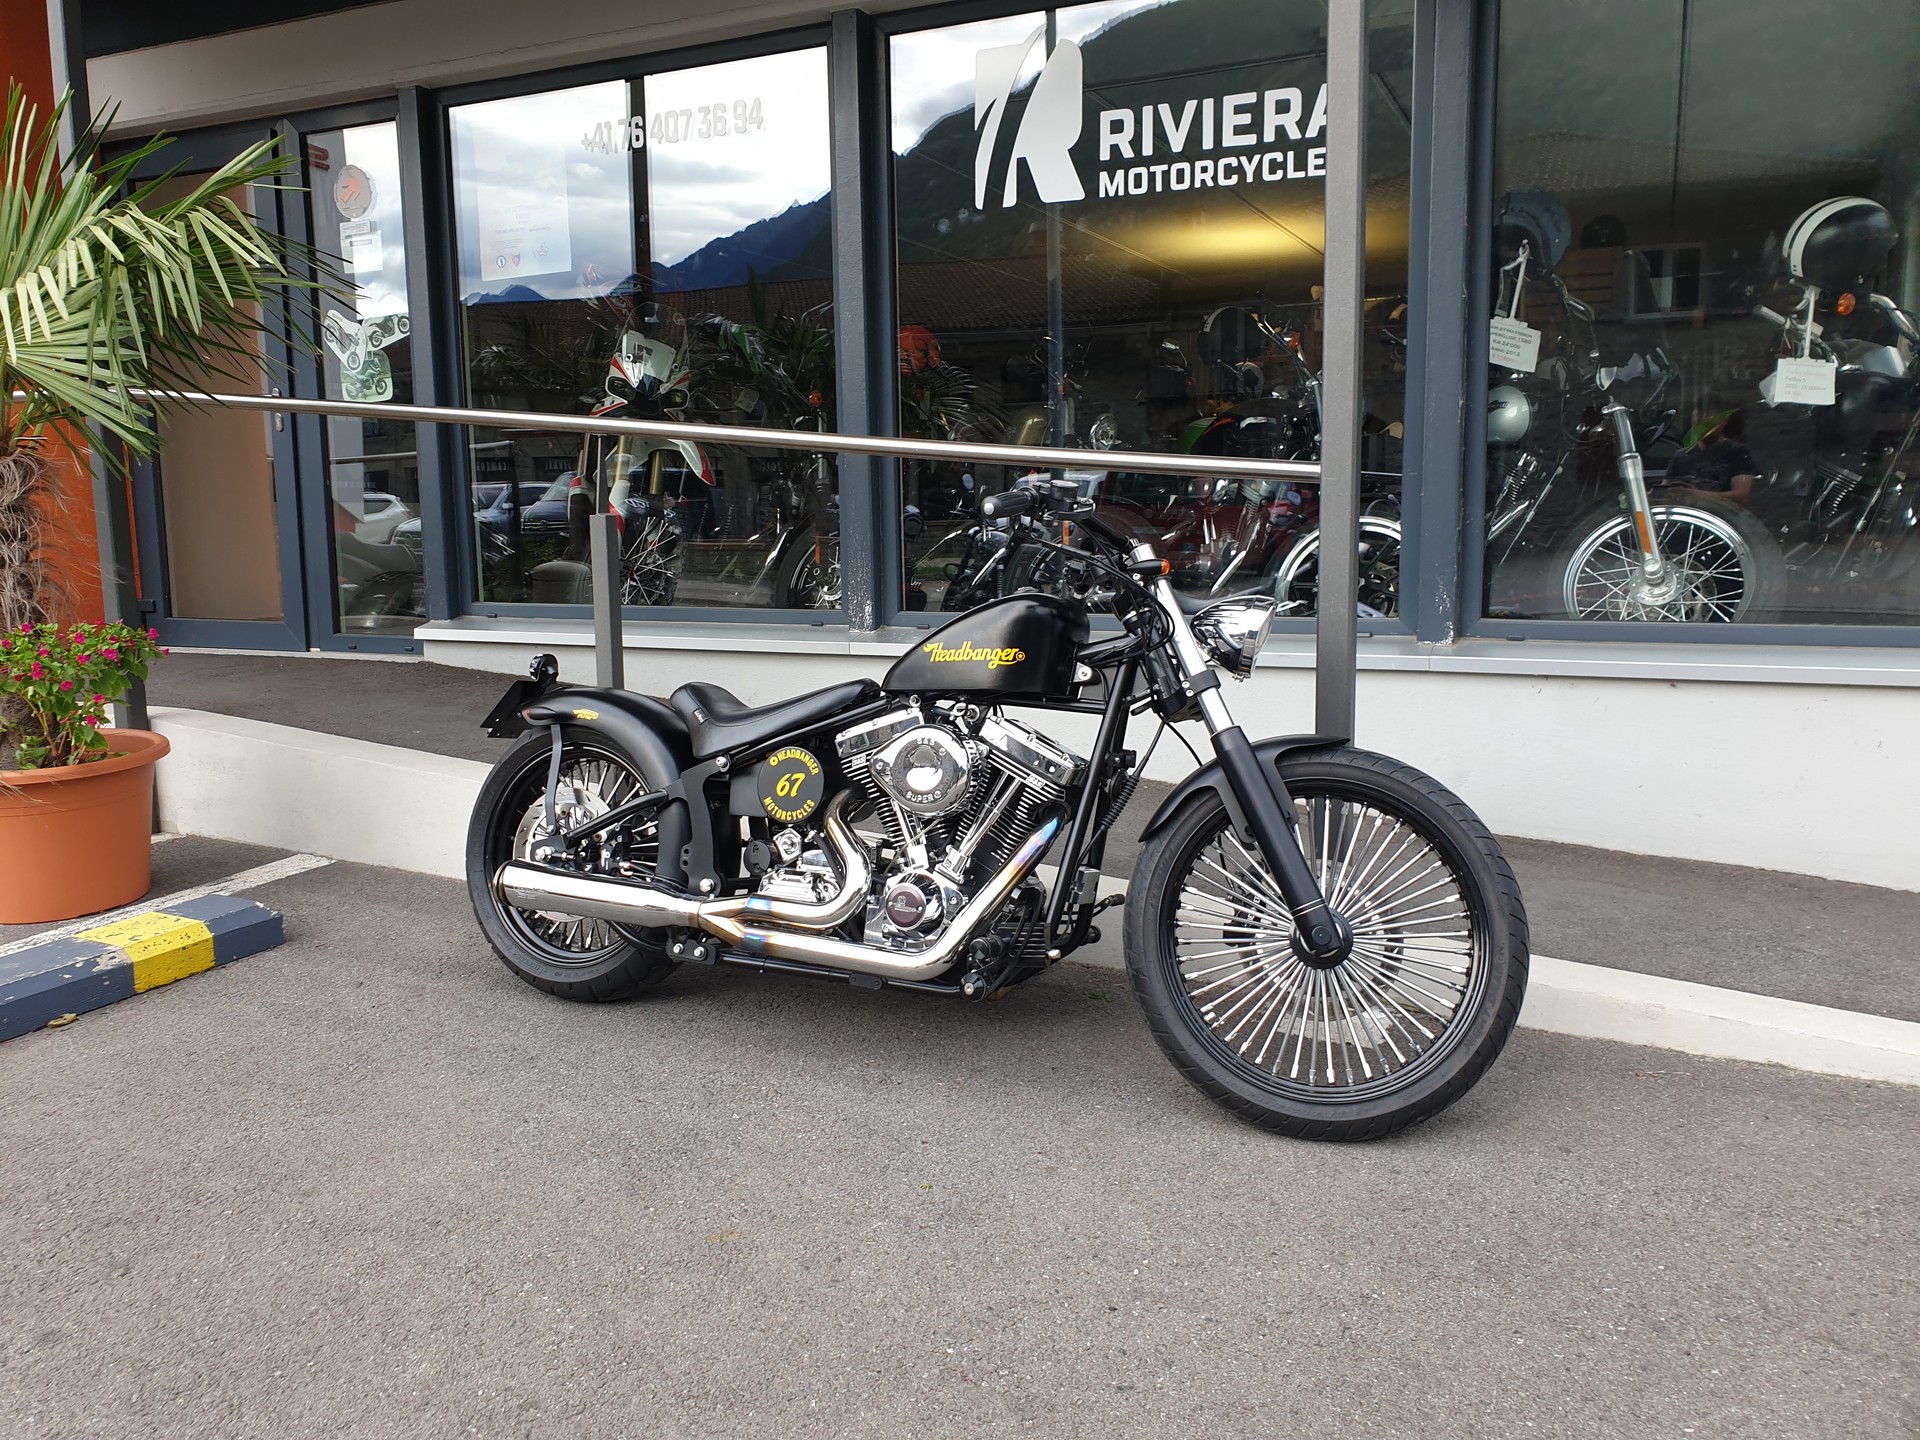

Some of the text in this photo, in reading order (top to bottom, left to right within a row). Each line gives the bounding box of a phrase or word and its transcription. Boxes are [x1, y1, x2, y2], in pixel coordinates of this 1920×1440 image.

[618, 115, 643, 149] 76
[650, 109, 692, 144] 407
[698, 103, 726, 138] 36
[733, 97, 763, 133] 94
[1099, 83, 1327, 161] RIVIERA
[1099, 147, 1327, 199] MOTORCYCLE
[923, 641, 1020, 669] Headbanger
[777, 749, 819, 775] HEADBANGER
[776, 772, 806, 797] 67
[906, 790, 935, 803] SUPER
[763, 796, 815, 821] MOTORCYCLES
